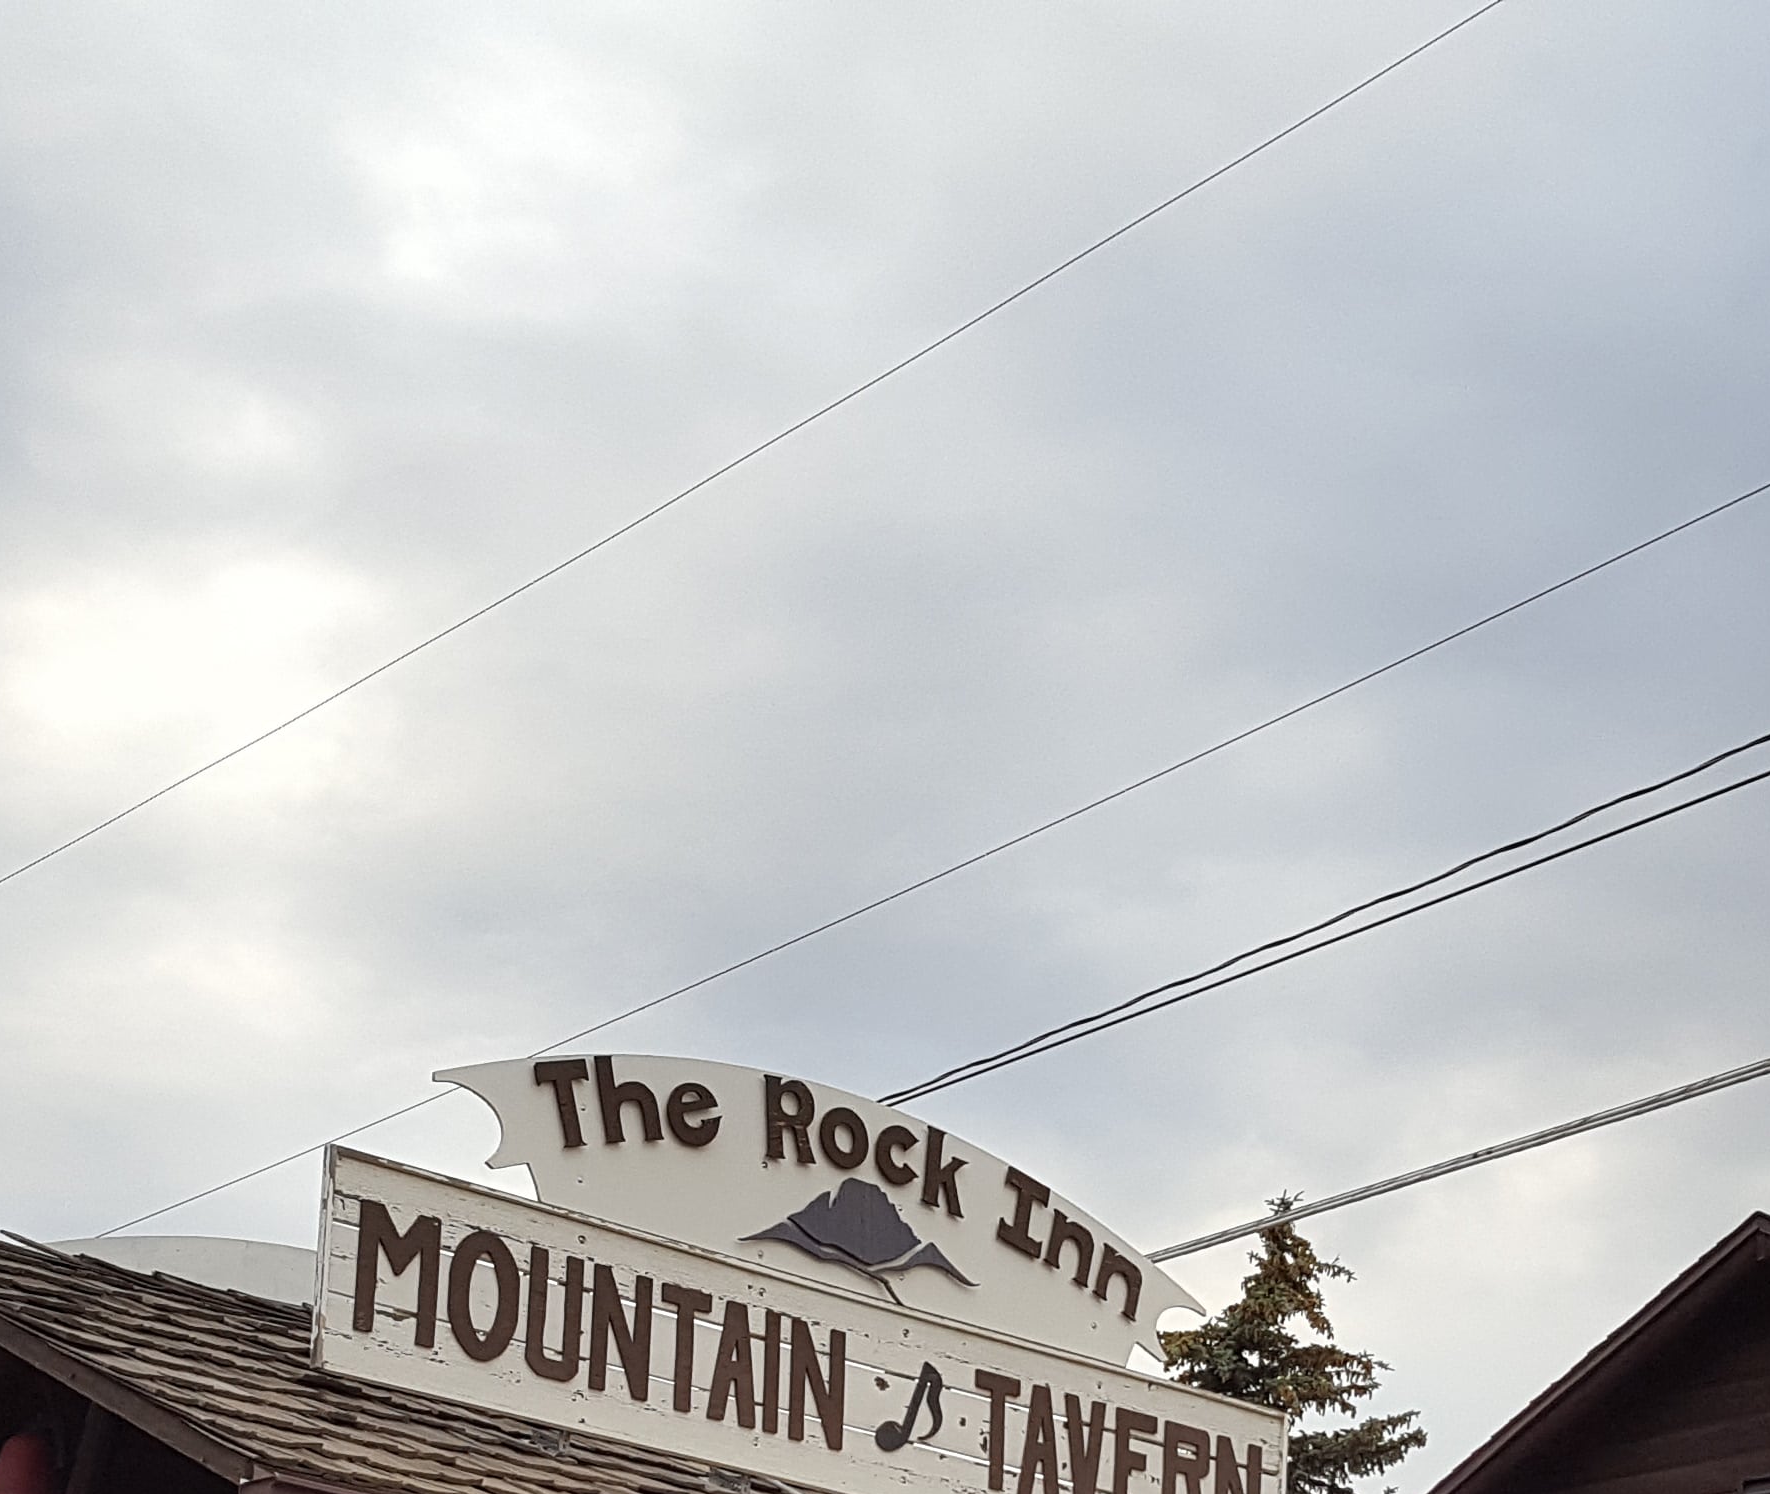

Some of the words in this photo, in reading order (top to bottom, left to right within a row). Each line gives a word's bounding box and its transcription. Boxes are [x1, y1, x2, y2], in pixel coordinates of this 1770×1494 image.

[534, 1056, 722, 1148] The
[763, 1074, 968, 1218] Rock
[996, 1166, 1143, 1322] Inn
[353, 1200, 845, 1450] MOUNTAIN
